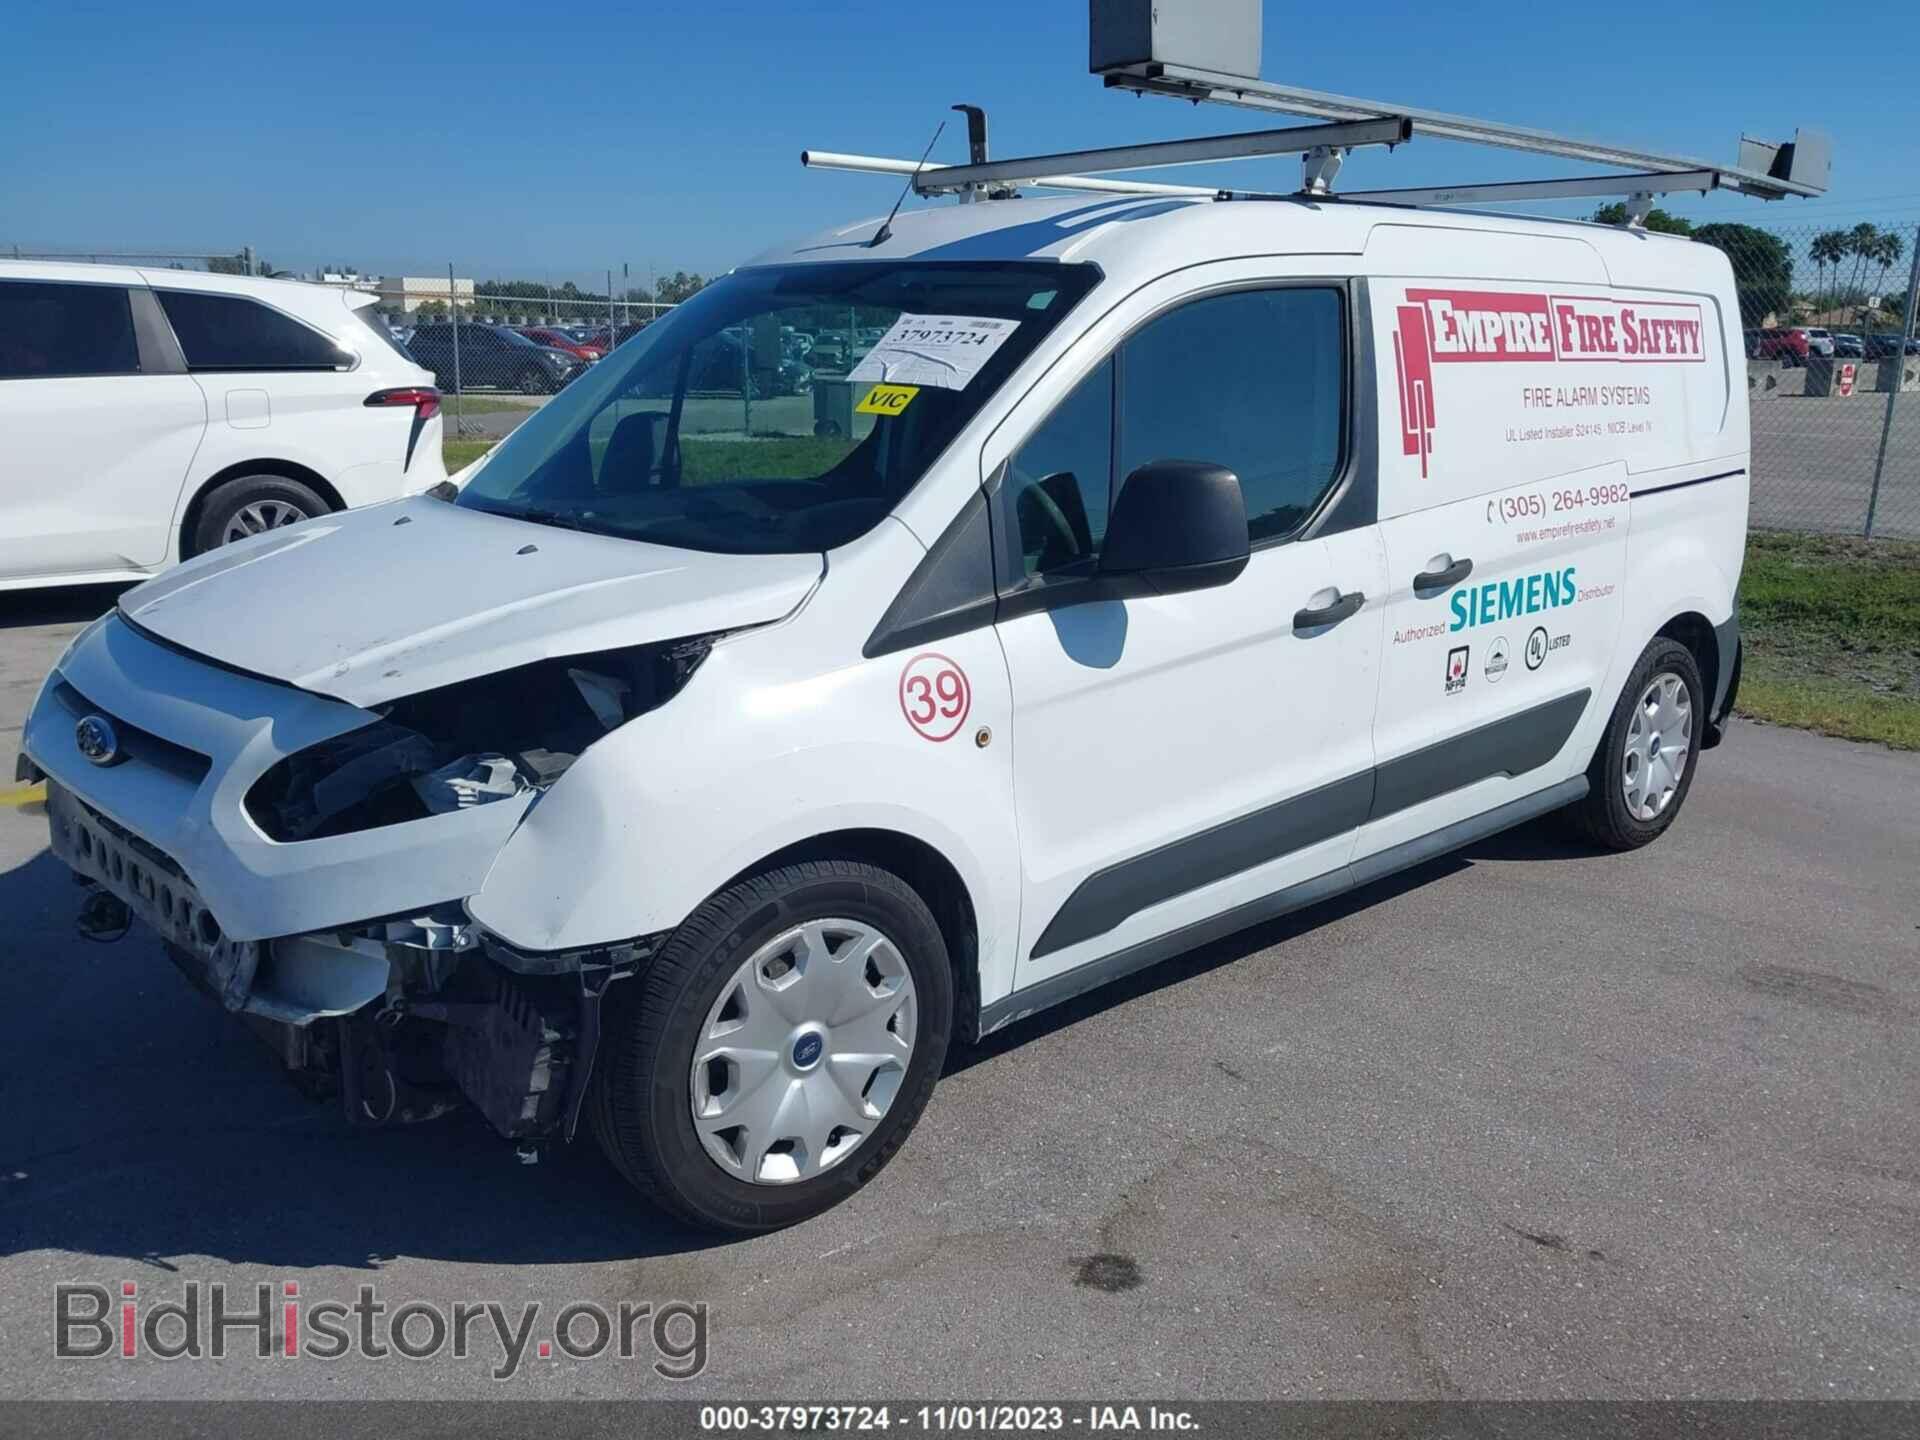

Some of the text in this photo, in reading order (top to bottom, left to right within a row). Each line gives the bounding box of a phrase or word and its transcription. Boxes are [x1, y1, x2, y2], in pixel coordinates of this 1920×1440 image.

[892, 328, 990, 346] 37973724
[1556, 304, 1618, 353] FIRE
[1621, 308, 1701, 355] SAFETY
[869, 391, 908, 408] VIC
[1523, 385, 1650, 408] FIRE ALARM SYSTEMS
[1519, 427, 1543, 441] Listed
[1545, 425, 1574, 439] Installer
[1500, 483, 1629, 524] (305) 264-9982
[1392, 567, 1615, 645] Authorized SIEMENS Distributor
[1530, 634, 1571, 660] UL LISTED
[906, 670, 964, 725] 39
